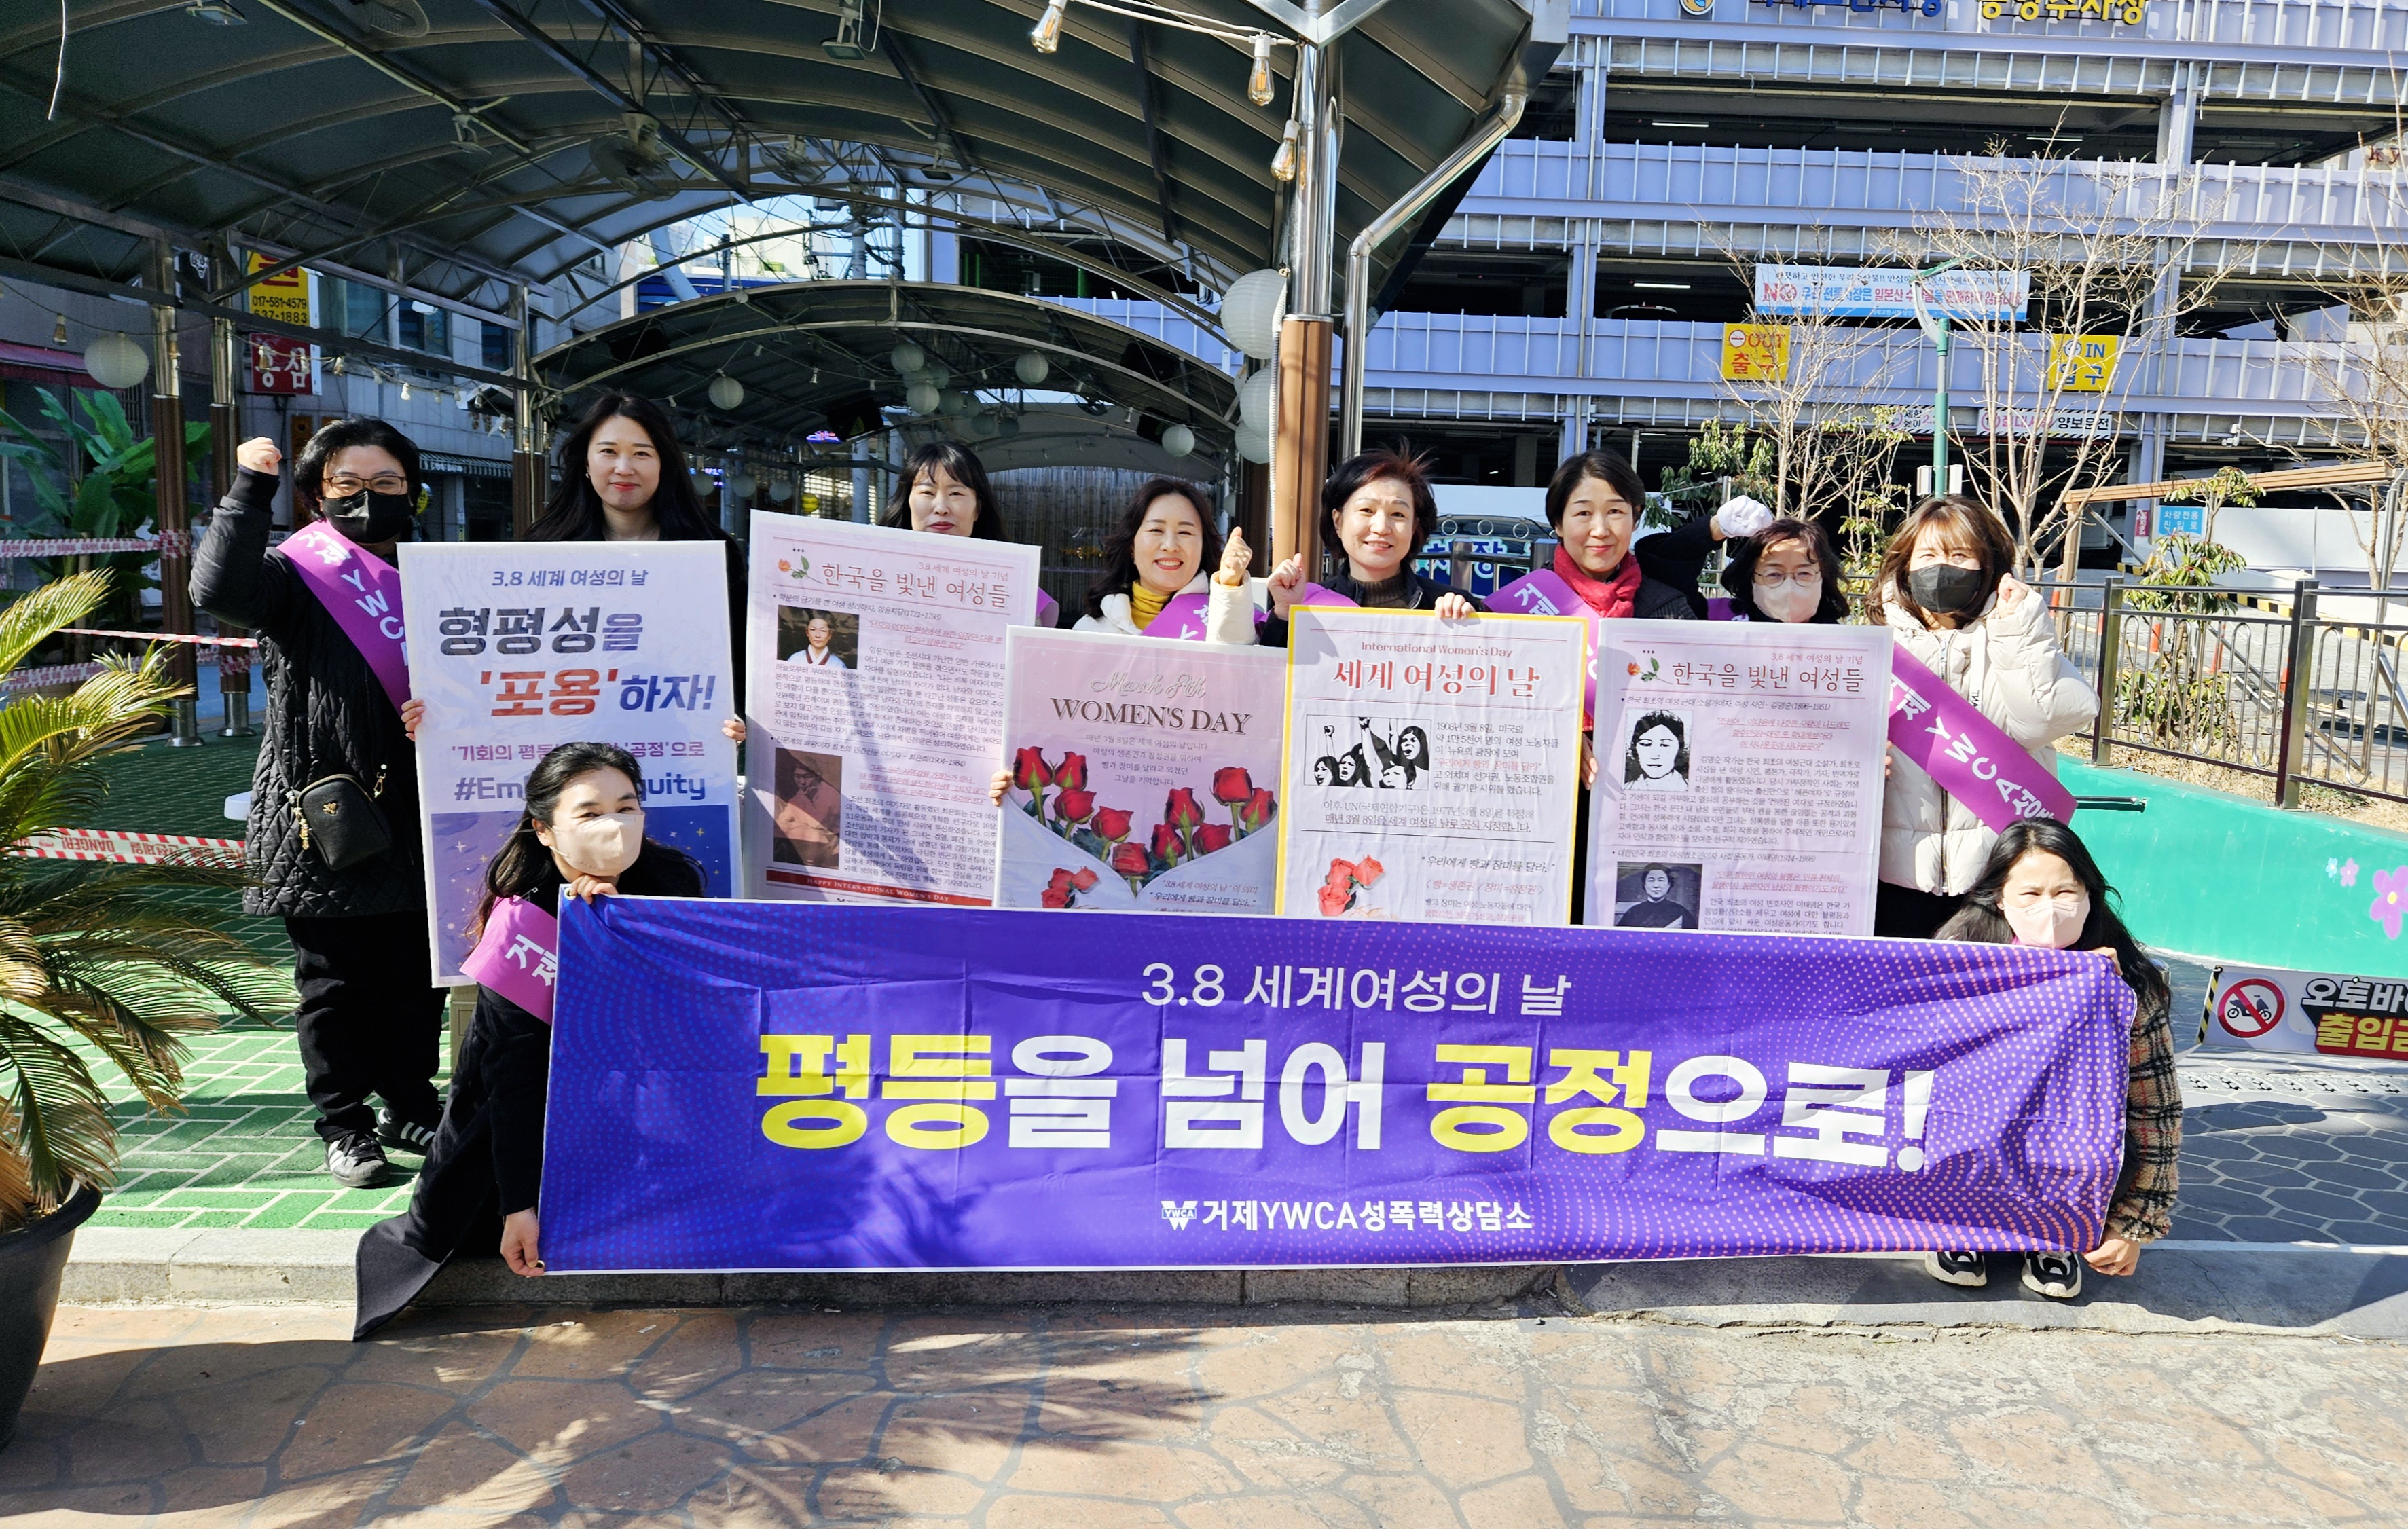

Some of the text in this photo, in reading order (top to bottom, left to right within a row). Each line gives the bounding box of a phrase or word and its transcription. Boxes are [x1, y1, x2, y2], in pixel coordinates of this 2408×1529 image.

[252, 295, 307, 310] 017-581-4579
[1875, 288, 1903, 302] 일본산
[1906, 289, 1943, 303] 수물을
[2085, 344, 2105, 358] IN
[2058, 416, 2109, 430] 양보운전
[2164, 510, 2198, 520] 차량전용
[492, 569, 649, 587] 3.8 세계 여성의 날
[918, 561, 1008, 581] 3.8 세계 여성의 날 기념
[821, 561, 1010, 608] 한국을 빛낸 여성들
[439, 606, 643, 656] 형평성을
[1362, 642, 1512, 658] International Women's Day
[1785, 652, 1803, 662] 세계
[1806, 653, 1831, 663] 여성의
[1834, 655, 1844, 664] 날
[1847, 655, 1863, 665] 기념
[1090, 671, 1206, 698] March 8th
[1332, 657, 1541, 697] 세계 여성의 날
[1671, 661, 1865, 693] 한국을 빛낸 여성들
[481, 668, 716, 717] '포용'하자!
[1049, 696, 1252, 735] WOMEN'S DAY
[1436, 721, 1462, 731] 1908년
[1463, 722, 1478, 732] 3월
[1499, 724, 1523, 734] 미국의
[1086, 733, 1101, 742] 매년
[1103, 734, 1114, 743] 3월
[1116, 735, 1135, 745] 8일은
[1137, 737, 1152, 747] 세계
[1154, 739, 1176, 749] 여성의
[1436, 733, 1444, 743] 약
[1446, 734, 1459, 743] 1만
[1485, 735, 1501, 745] 명의
[1506, 737, 1522, 746] 여성
[1525, 737, 1558, 748] 노동자들
[624, 741, 706, 758] '공정'으로
[1435, 745, 1518, 758] 이 뉴욕의 광장에 모여
[1102, 760, 1188, 775] 빵과 장미를 달라고 외쳤던
[1114, 773, 1135, 784] 그날을
[1434, 769, 1442, 779] 고
[1444, 770, 1469, 780] 외치며
[1504, 773, 1554, 784] 노동조합권을
[1325, 812, 1343, 823] 매년
[1345, 813, 1360, 824] 3월
[1362, 814, 1386, 825] 8일을
[1388, 815, 1406, 826] 세계
[1409, 817, 1436, 828] 여성의
[1440, 818, 1458, 828] 날로
[1461, 819, 1479, 830] 공식
[61, 836, 116, 853] DANGER!
[1427, 855, 1466, 868] 우리에게
[1470, 858, 1489, 870] 빵과
[1492, 859, 1522, 872] 장미를
[1176, 879, 1192, 889] 세계
[1194, 881, 1217, 891] 여성의
[1142, 962, 1572, 1016] 3.8 세계여성의 날
[756, 1033, 1935, 1173] 평등을 넘어 공정으로!
[1163, 1209, 1195, 1219] YWCA
[1202, 1199, 1533, 1232] 거제YWCA성폭력상담소
